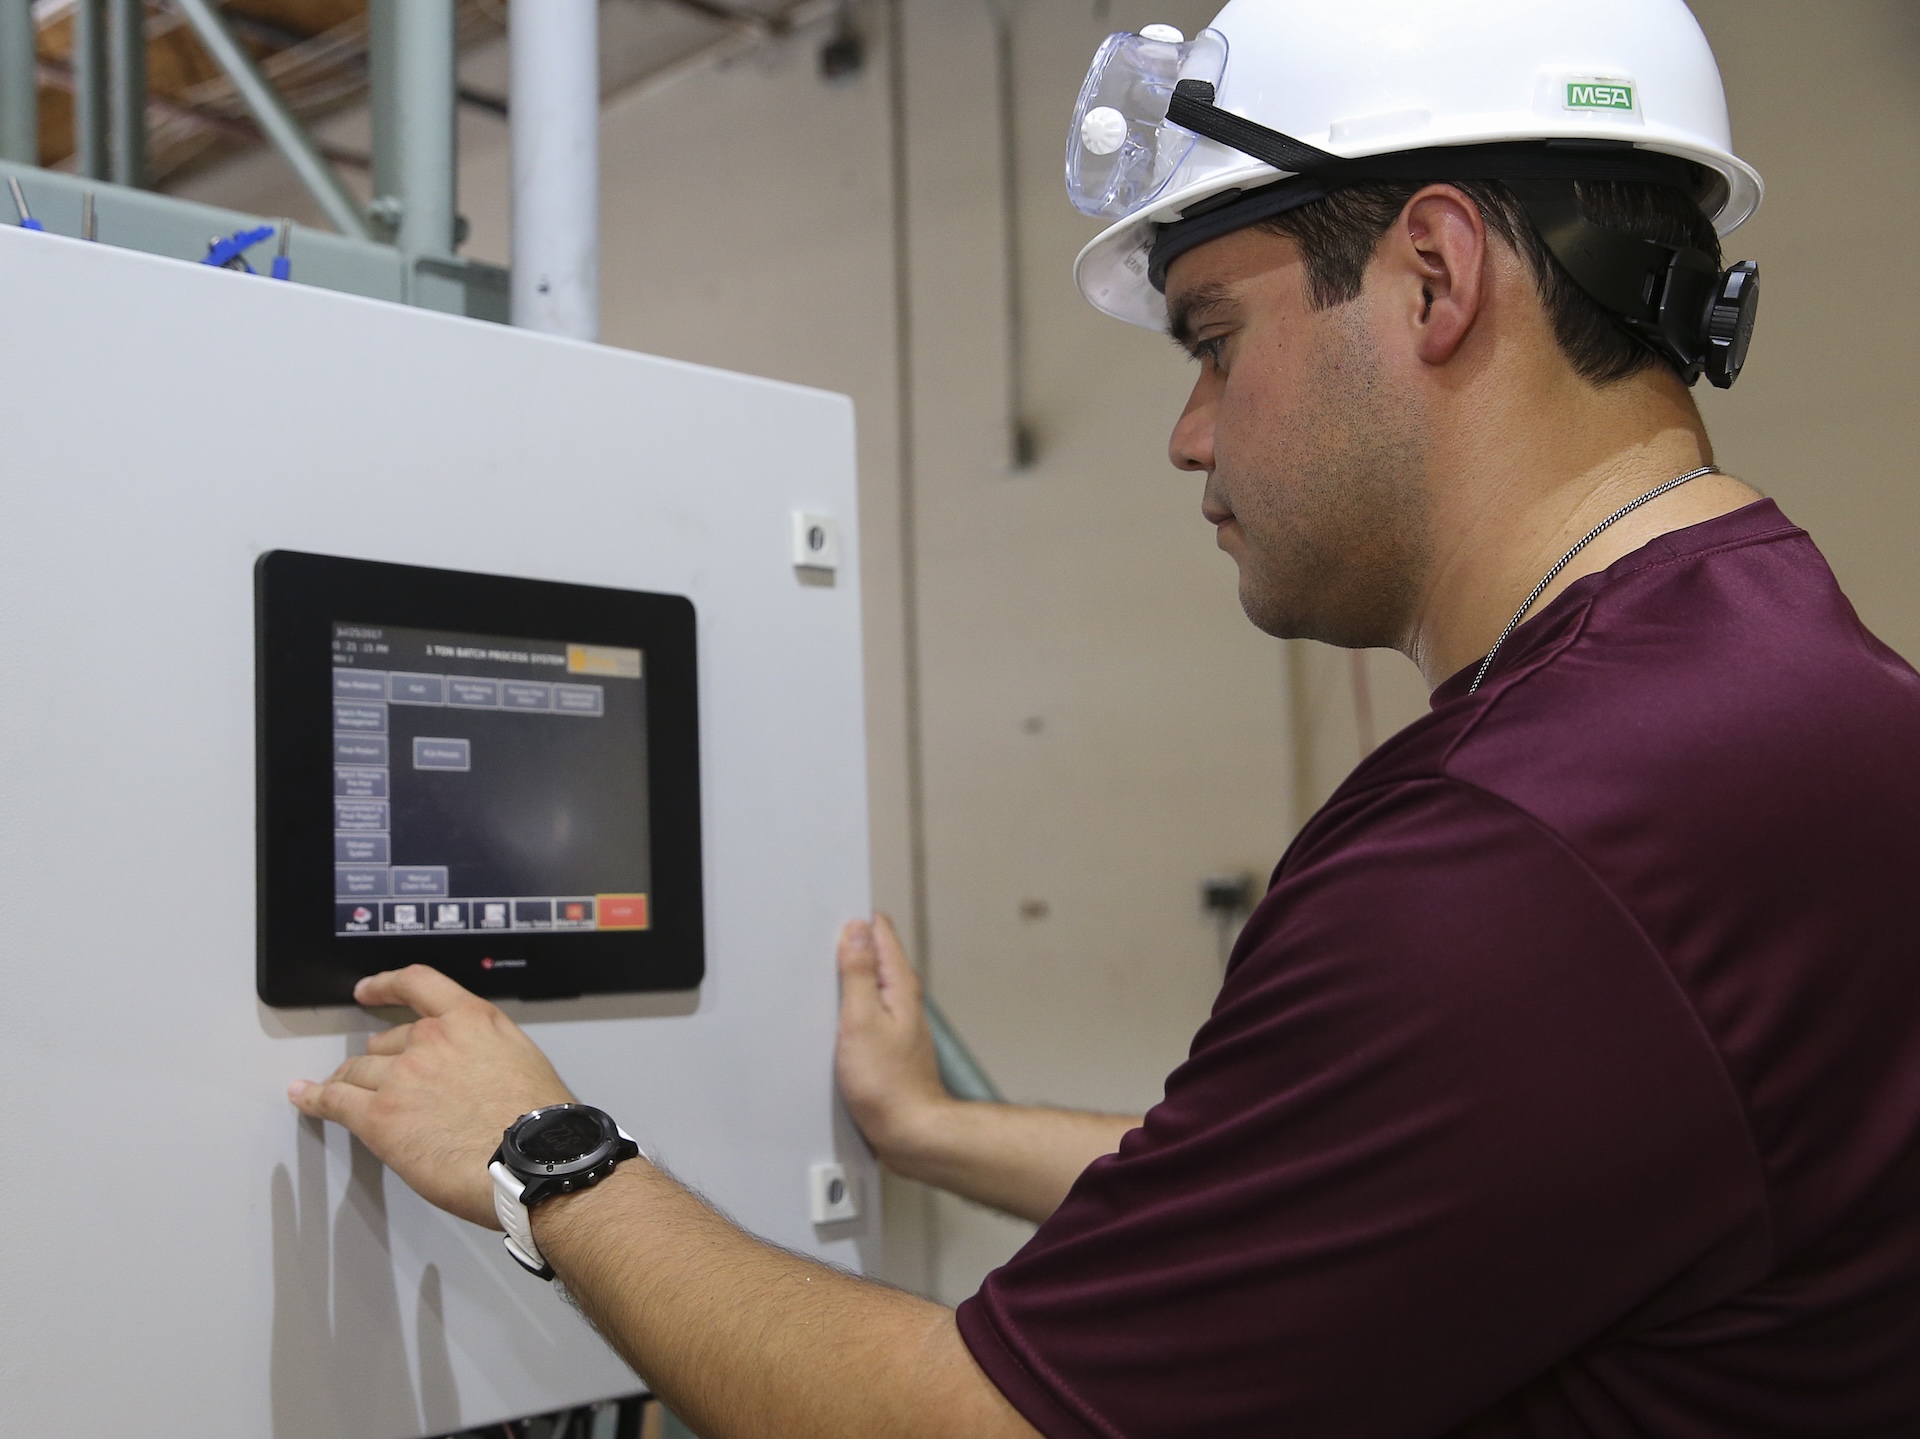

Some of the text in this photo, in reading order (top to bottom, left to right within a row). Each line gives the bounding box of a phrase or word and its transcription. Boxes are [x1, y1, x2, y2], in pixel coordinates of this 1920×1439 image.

[1571, 86, 1630, 107] MSA
[433, 645, 455, 657] TON
[456, 646, 487, 660] BATCH
[487, 649, 529, 663] PROCESS
[529, 652, 565, 666] SYSTEM
